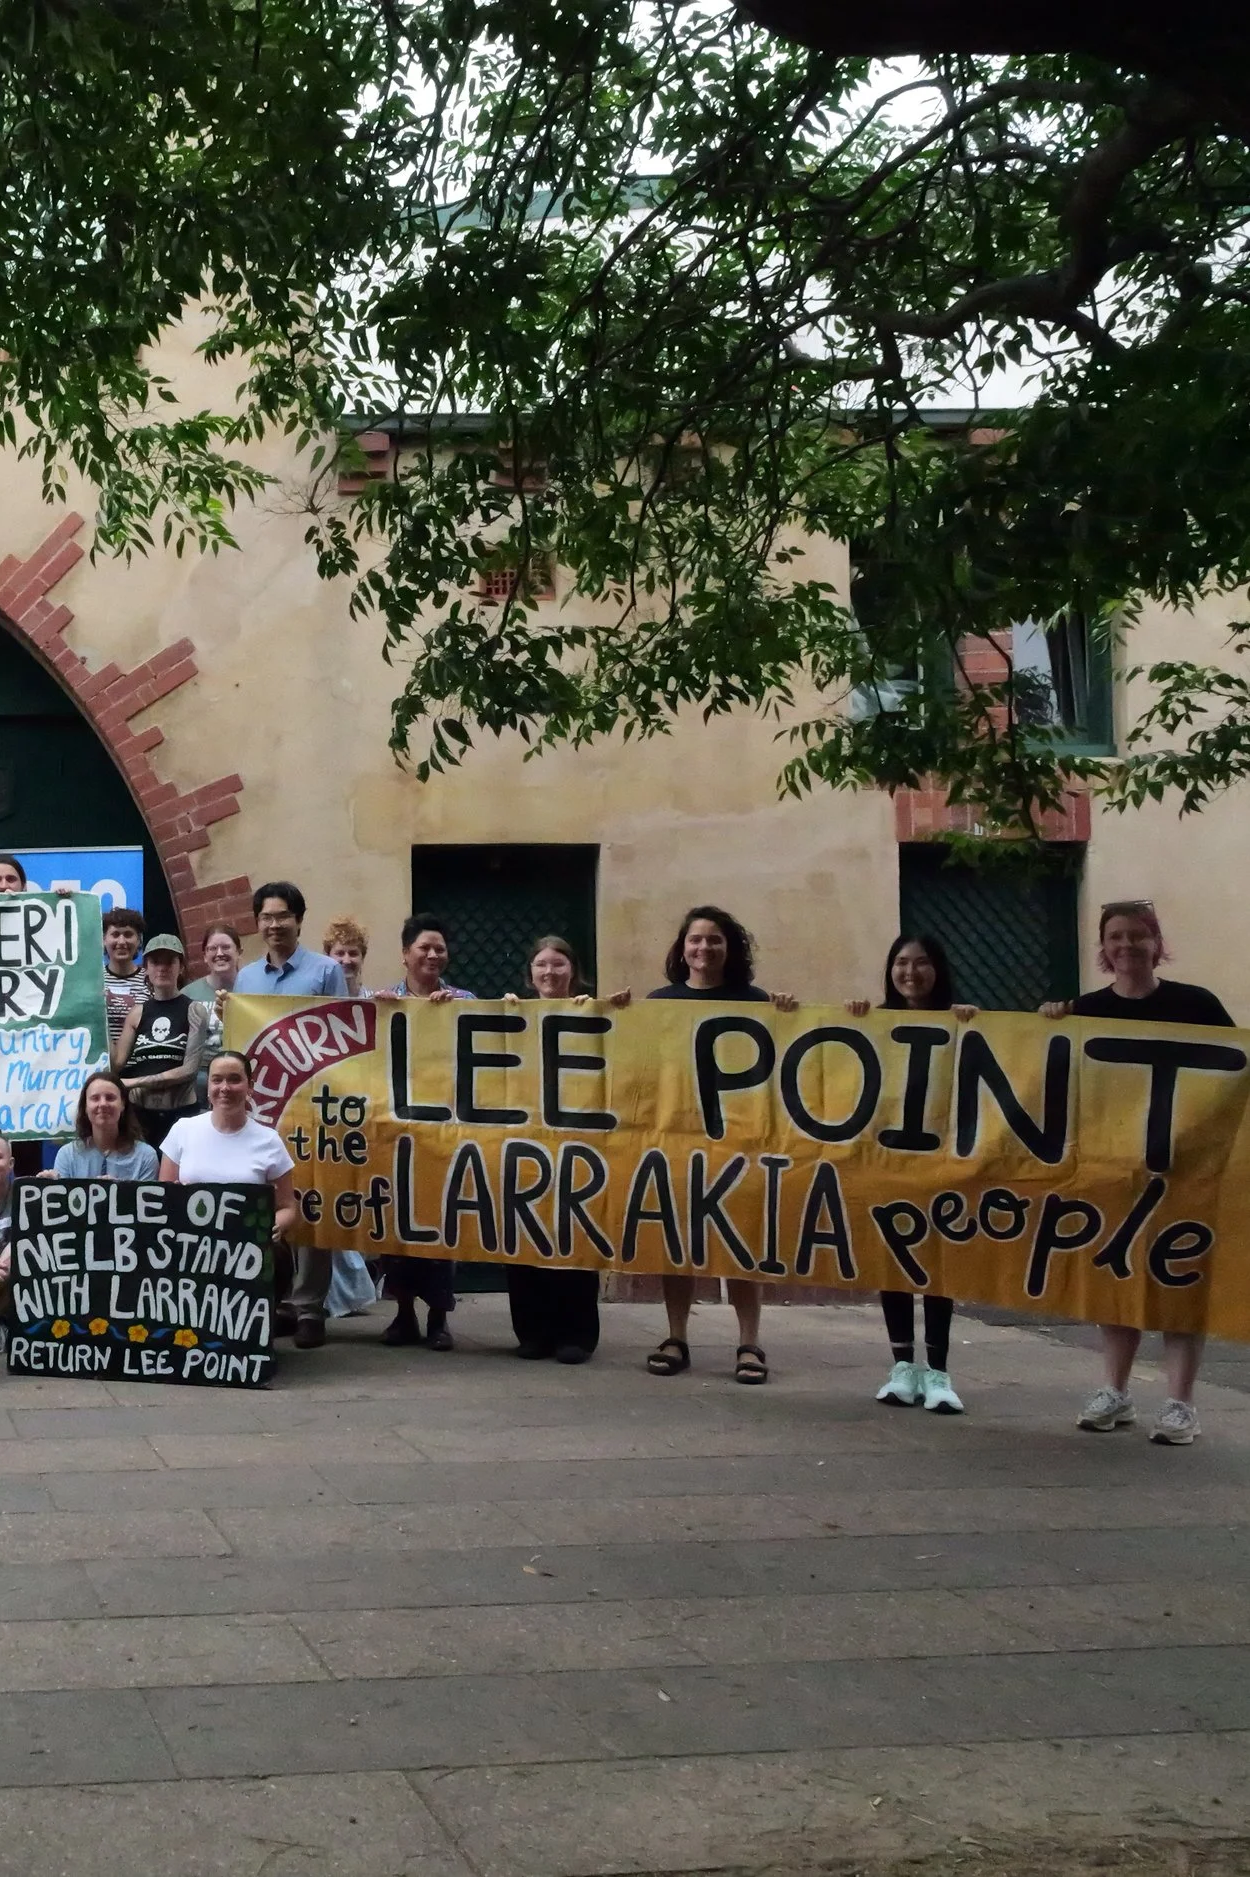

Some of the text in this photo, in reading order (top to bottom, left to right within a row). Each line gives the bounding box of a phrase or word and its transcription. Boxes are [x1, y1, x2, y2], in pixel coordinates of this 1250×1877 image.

[311, 1084, 368, 1128] to
[390, 1011, 1247, 1174] LEE POINT
[287, 1126, 368, 1165] the
[18, 1183, 168, 1231] PEOPLE
[186, 1189, 247, 1231] OF
[335, 1176, 392, 1240] of
[394, 1136, 1213, 1298] LARRAKIA people
[16, 1227, 263, 1280] MELB STAND
[13, 1273, 270, 1347] WITH LARRAKIA
[9, 1336, 271, 1383] RETURN LEE POINT
